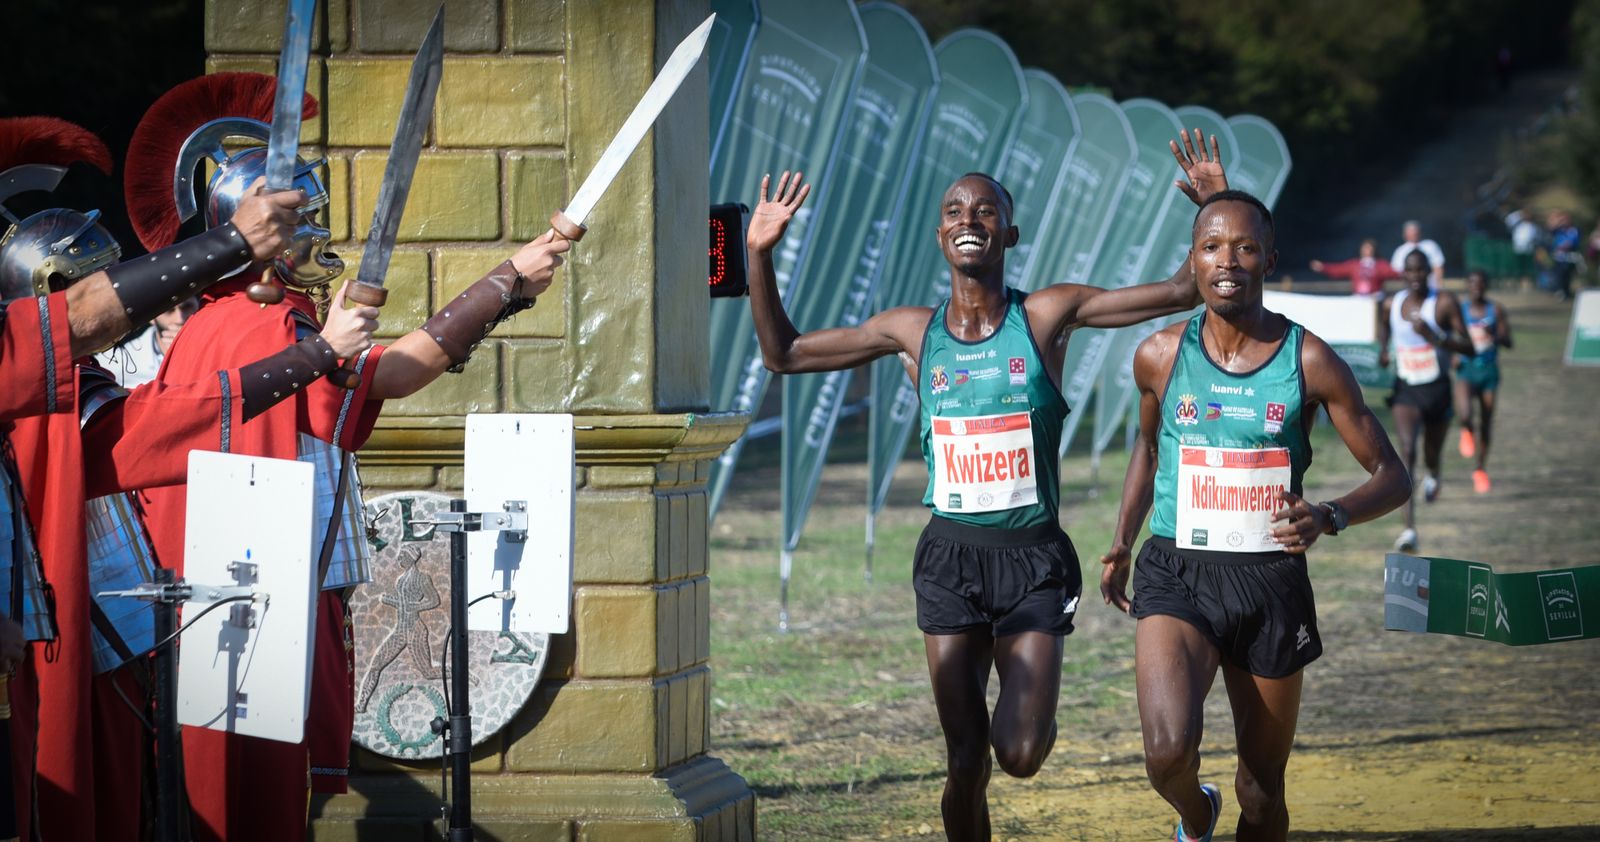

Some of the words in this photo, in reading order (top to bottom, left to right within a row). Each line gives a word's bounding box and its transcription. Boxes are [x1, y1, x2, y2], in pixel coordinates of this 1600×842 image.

[956, 350, 986, 362] luanvi
[1211, 383, 1242, 396] luanvi
[943, 442, 1031, 485] Kwizera
[1191, 474, 1285, 517] Ndikumwenayo
[1549, 610, 1577, 621] SEVILLA
